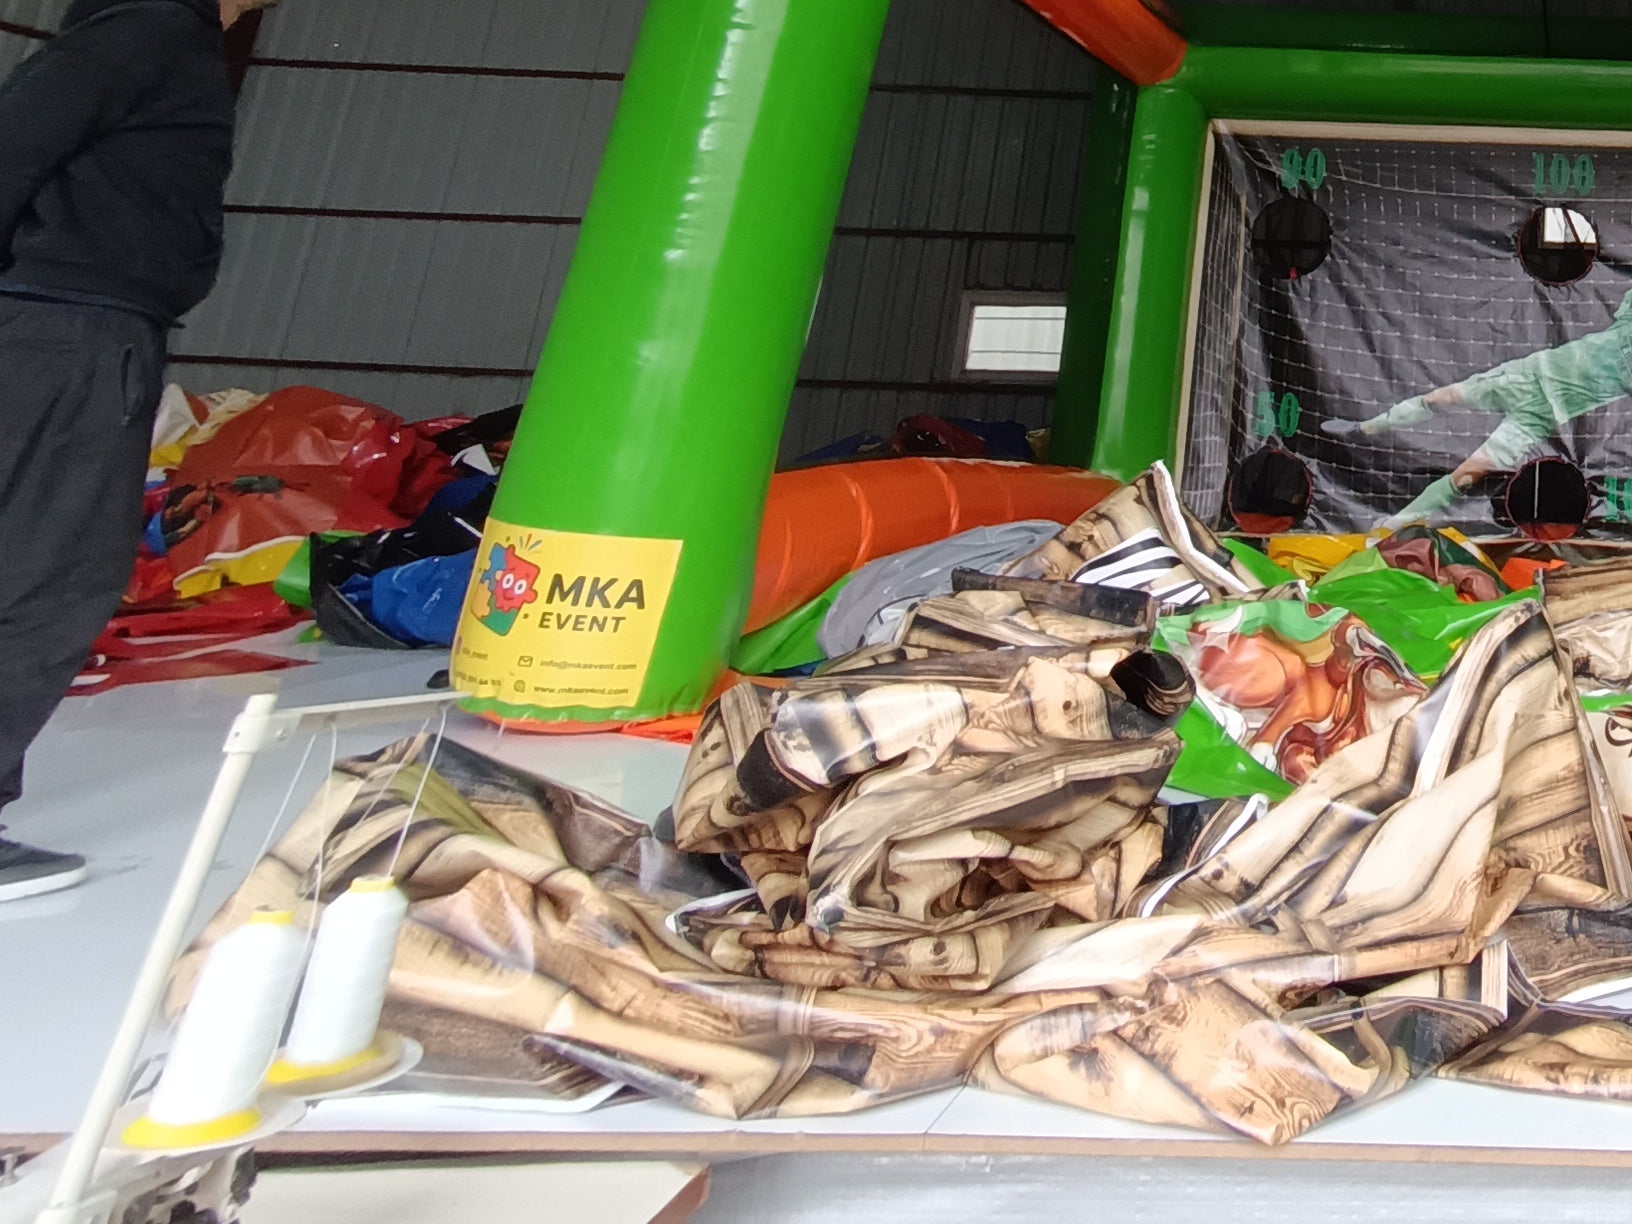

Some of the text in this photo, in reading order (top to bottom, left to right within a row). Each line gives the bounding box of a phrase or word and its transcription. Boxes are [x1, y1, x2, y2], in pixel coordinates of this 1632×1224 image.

[1281, 147, 1326, 190] 90
[1532, 152, 1595, 195] 100
[1255, 390, 1300, 437] 50
[545, 573, 646, 610] MKA
[538, 611, 626, 633] EVENT
